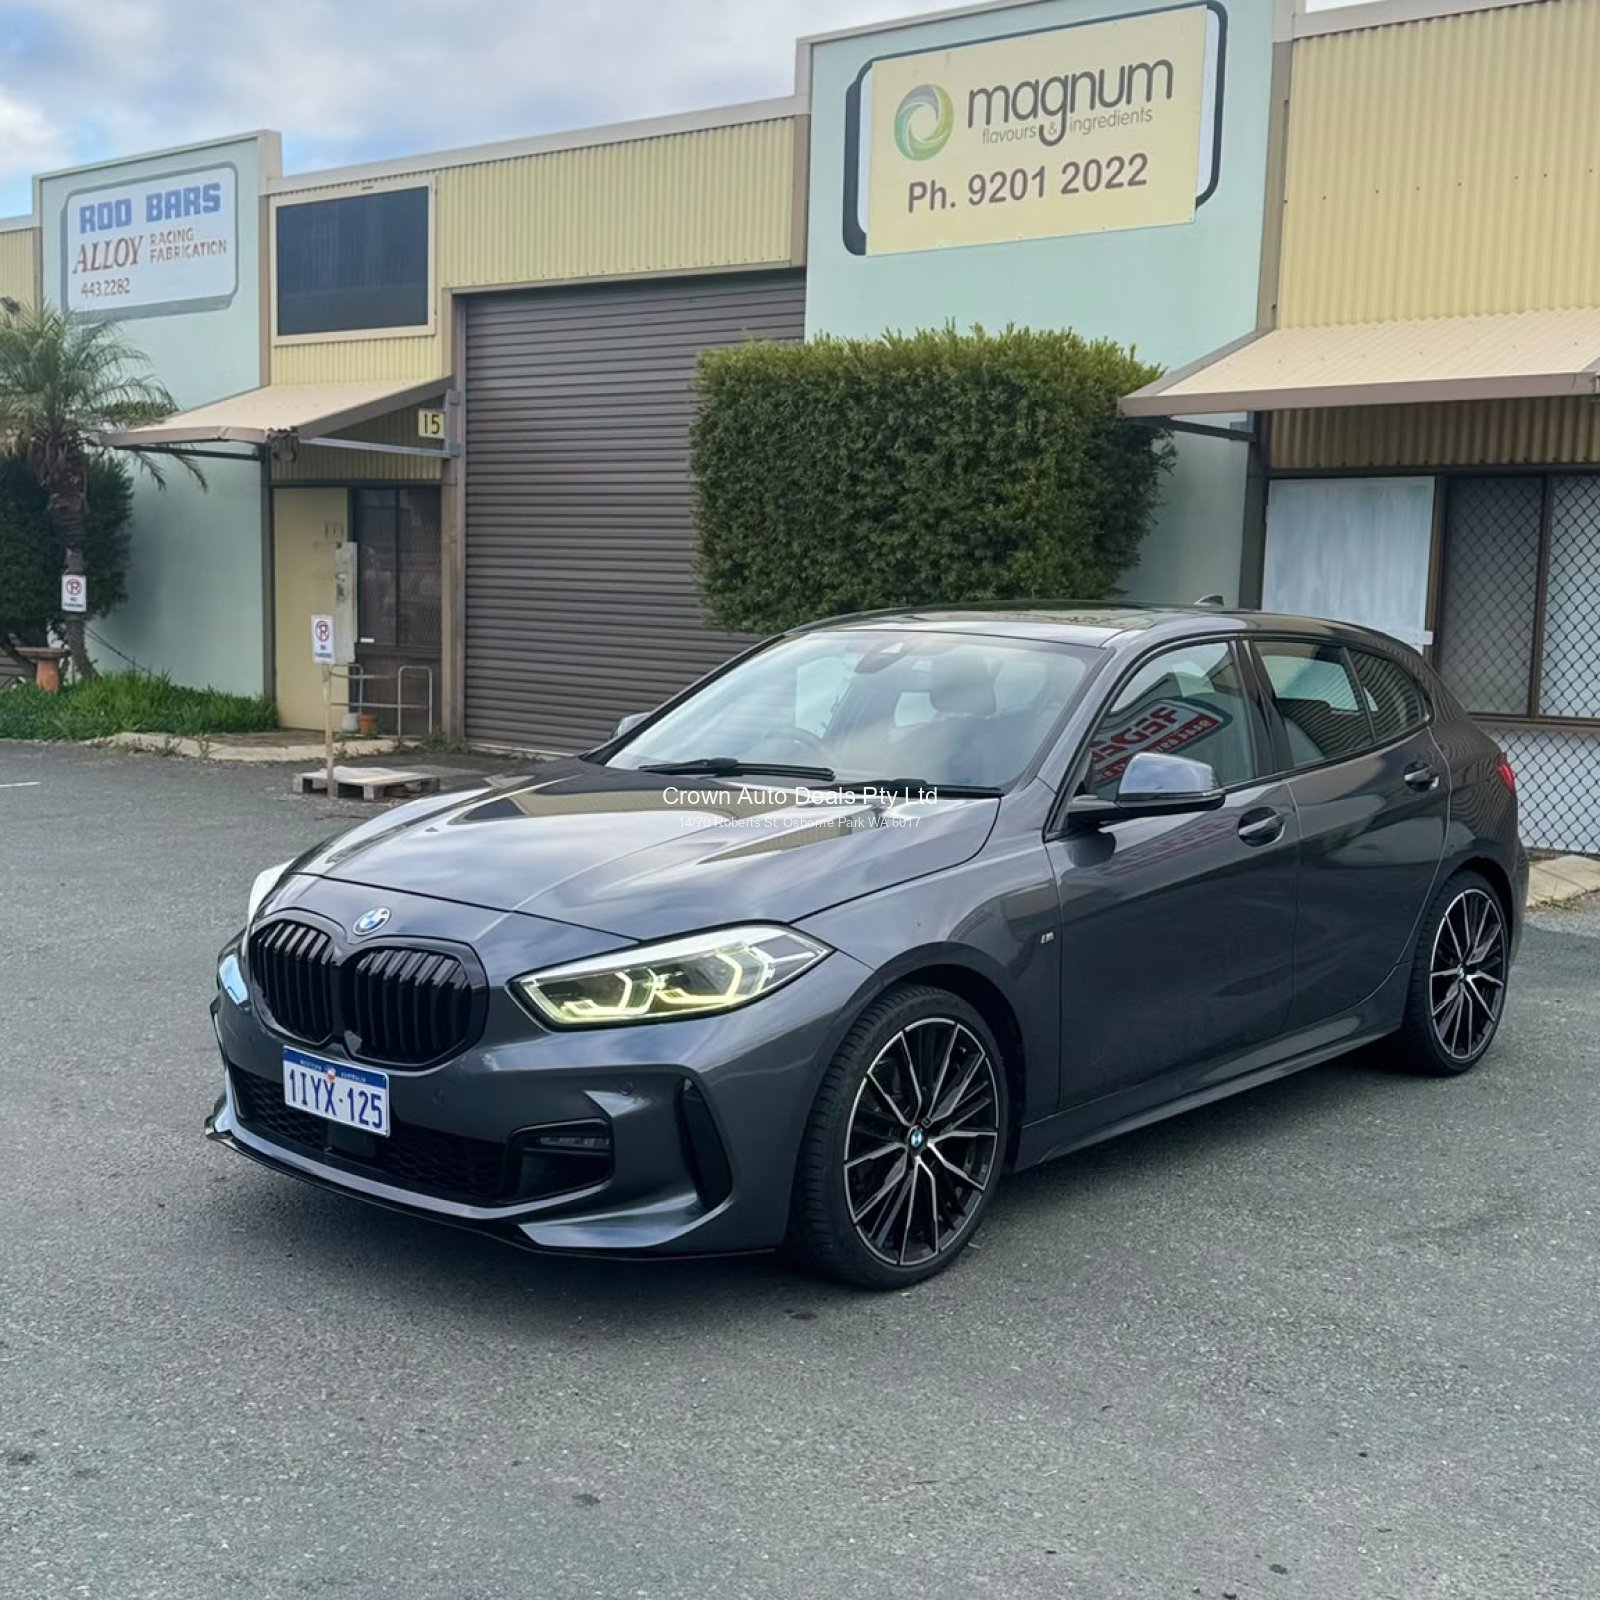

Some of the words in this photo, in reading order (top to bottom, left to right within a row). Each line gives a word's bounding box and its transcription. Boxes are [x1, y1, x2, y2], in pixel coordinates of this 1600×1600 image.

[967, 59, 1173, 146] magnum
[982, 124, 1037, 145] flavours
[1047, 122, 1058, 136] &
[1069, 107, 1153, 136] ingredients
[146, 182, 221, 222] BARS
[908, 179, 956, 214] Ph.
[968, 166, 1046, 206] 9201
[1061, 153, 1148, 194] 2022
[72, 235, 143, 274] ALLOY
[150, 228, 194, 245] RACING
[150, 239, 227, 264] FABRICATION
[424, 413, 440, 435] 15
